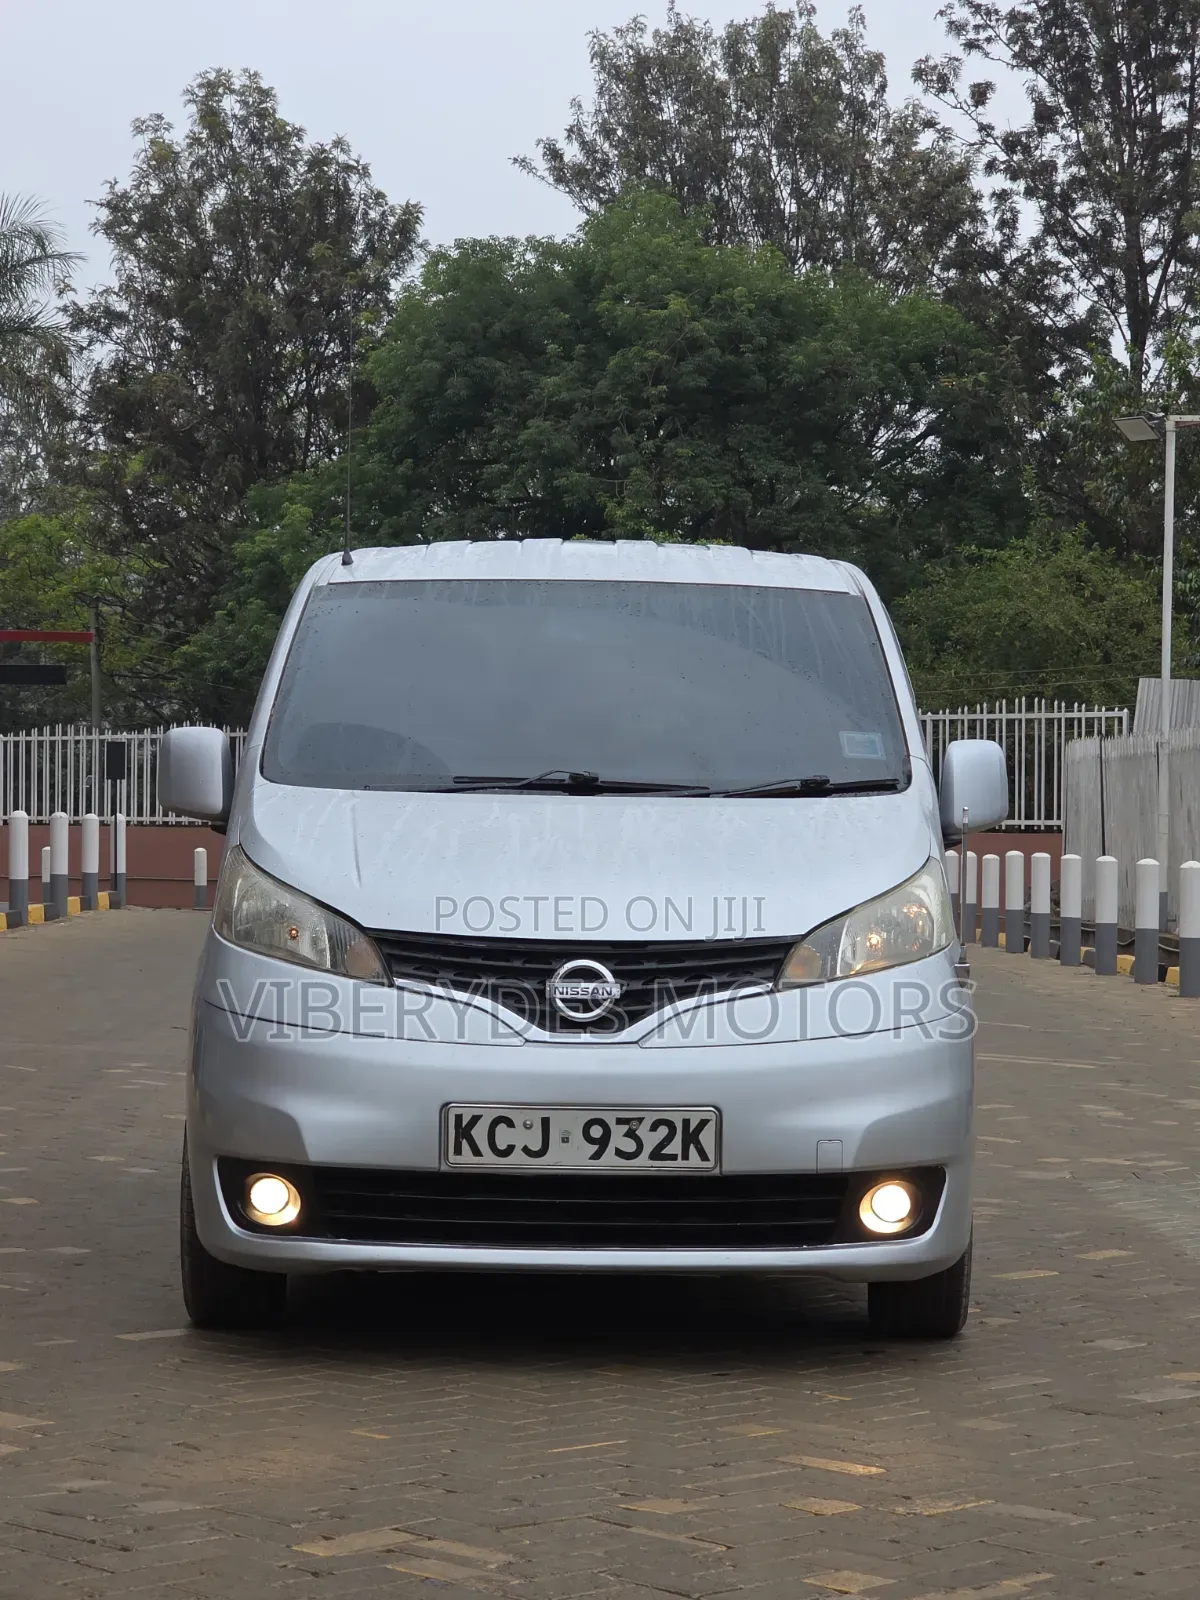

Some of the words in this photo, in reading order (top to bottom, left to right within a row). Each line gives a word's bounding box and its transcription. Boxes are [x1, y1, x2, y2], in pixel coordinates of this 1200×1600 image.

[553, 986, 613, 996] NISSAN
[453, 1113, 551, 1159] KCJ
[581, 1116, 713, 1162] 932K
